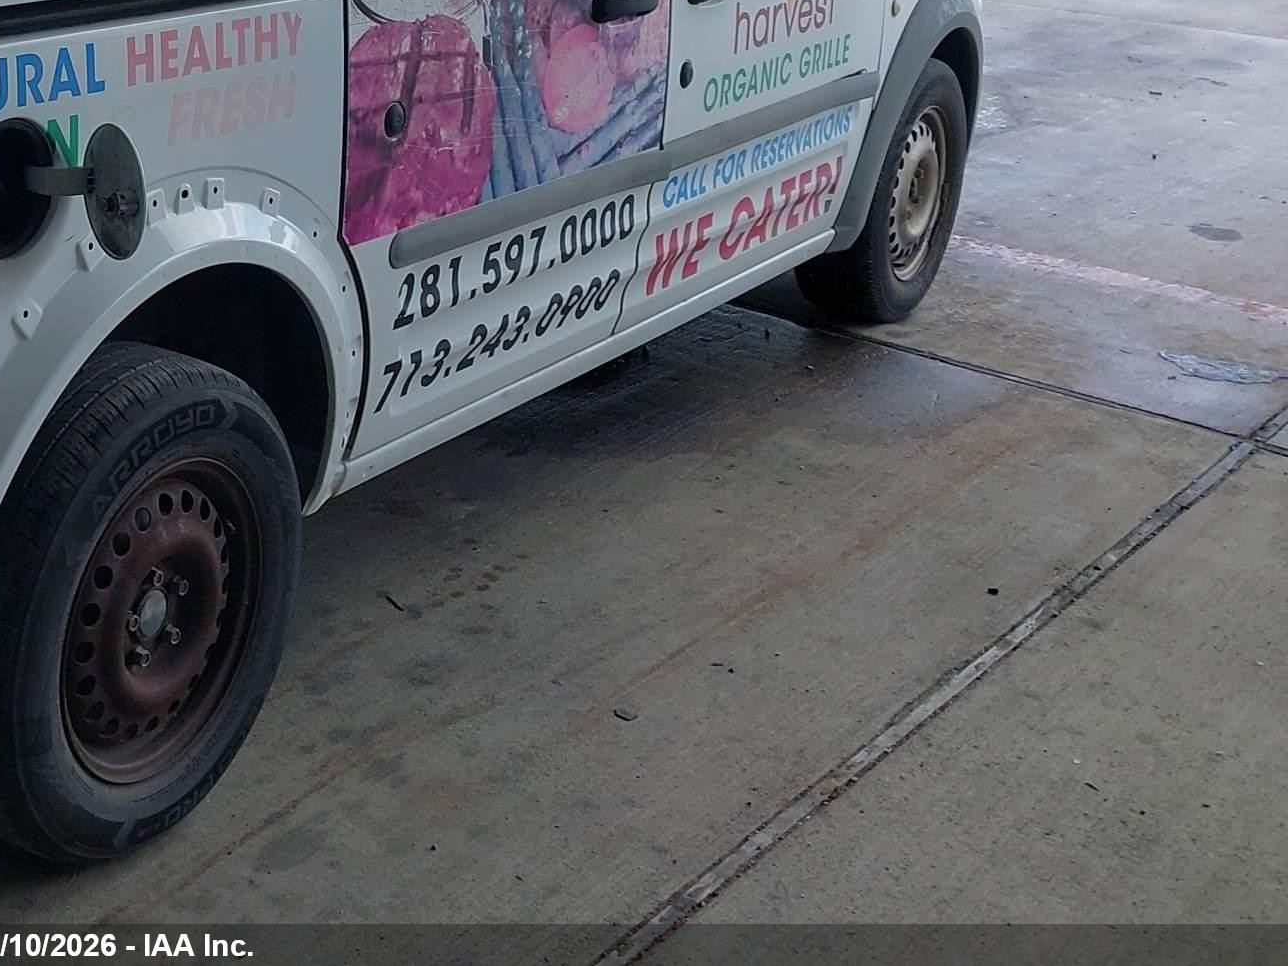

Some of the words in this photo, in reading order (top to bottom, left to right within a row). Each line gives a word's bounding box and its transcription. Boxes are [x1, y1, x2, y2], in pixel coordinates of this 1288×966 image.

[126, 11, 303, 87] HEALTHY
[703, 59, 792, 113] ORGANIC
[798, 34, 851, 79] GRILLE
[167, 71, 297, 146] FRESH
[662, 171, 707, 208] CALL
[712, 157, 747, 189] FOR
[751, 105, 853, 177] RESERVATIONS
[393, 195, 636, 331] 281.597.0000
[644, 210, 714, 297] WE
[718, 155, 845, 261] CATER!
